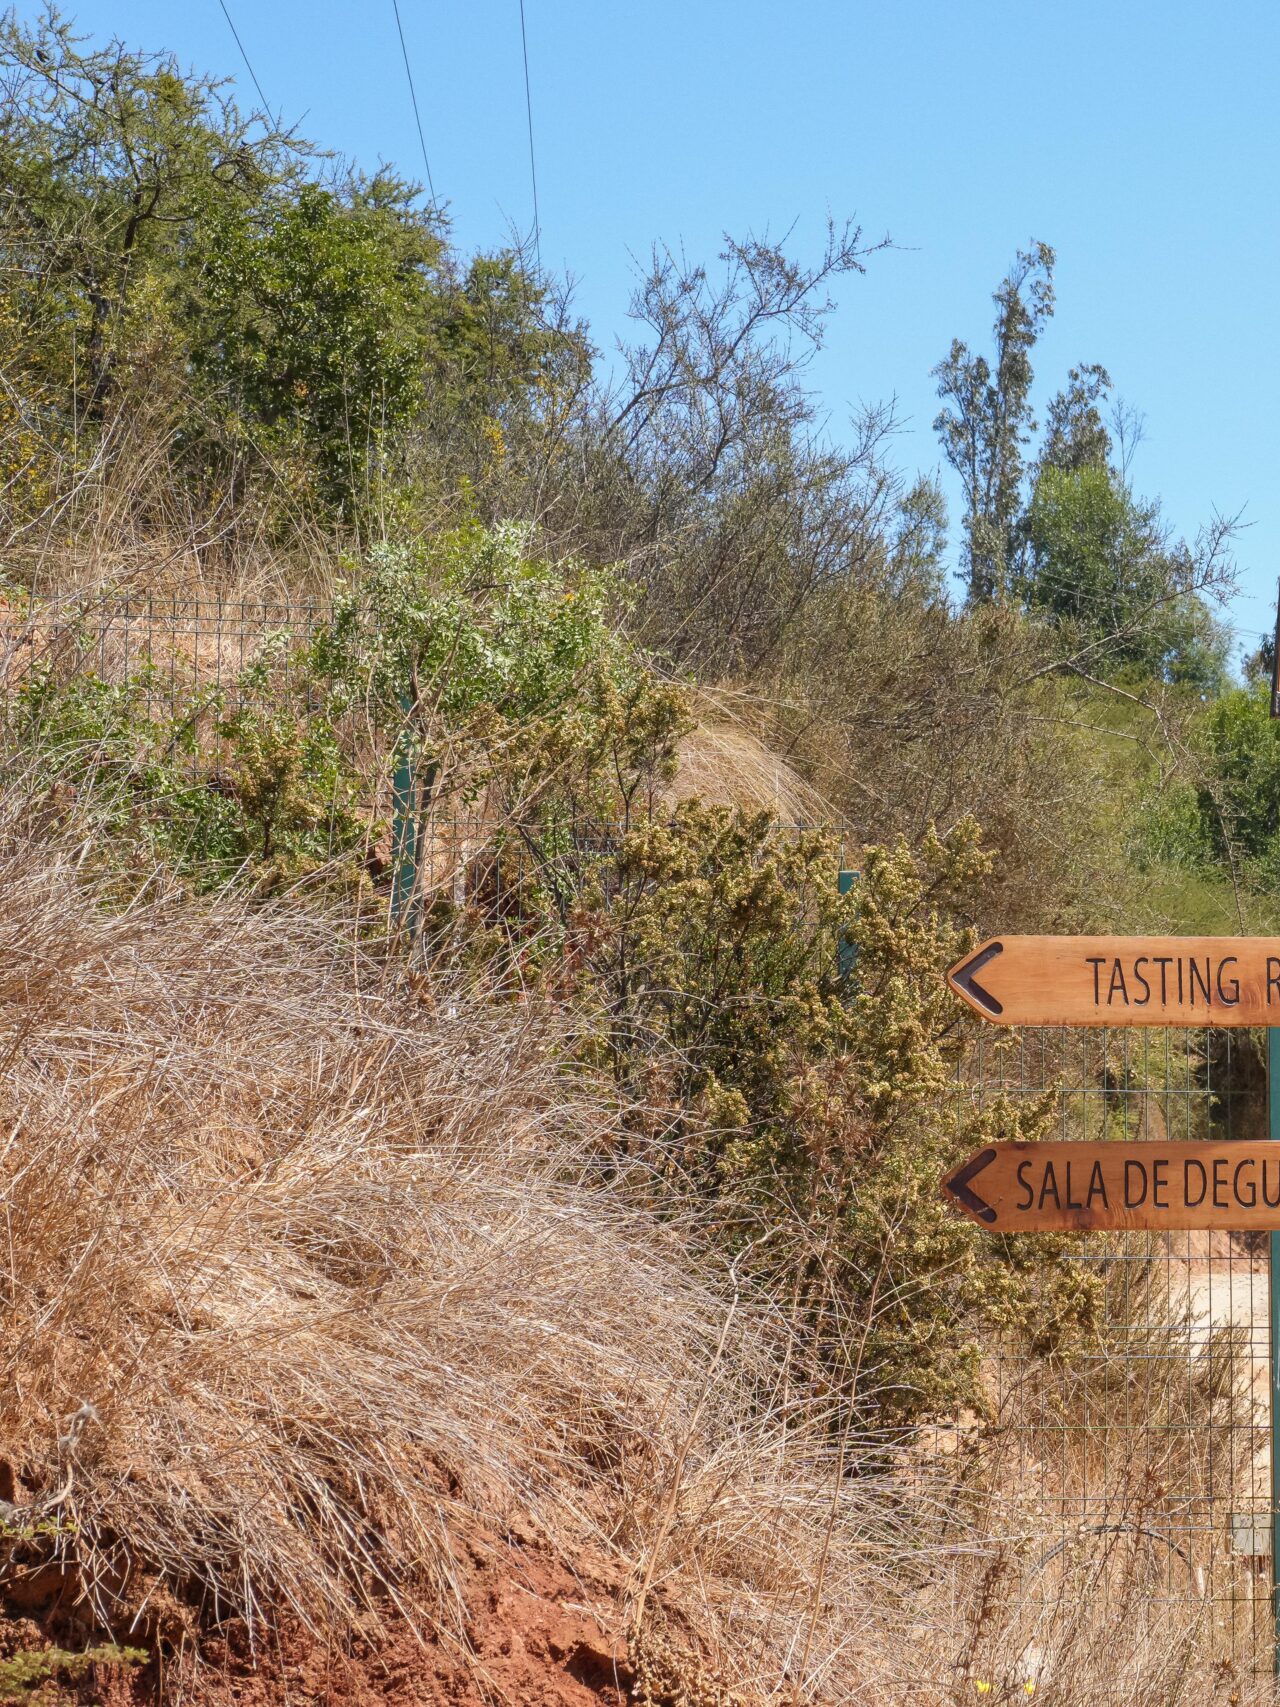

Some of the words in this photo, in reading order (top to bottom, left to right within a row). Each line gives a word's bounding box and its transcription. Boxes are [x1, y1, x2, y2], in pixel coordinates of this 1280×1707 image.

[1085, 957, 1240, 1006] TASTING
[1017, 1160, 1108, 1210] SALA
[1124, 1160, 1169, 1210] DE
